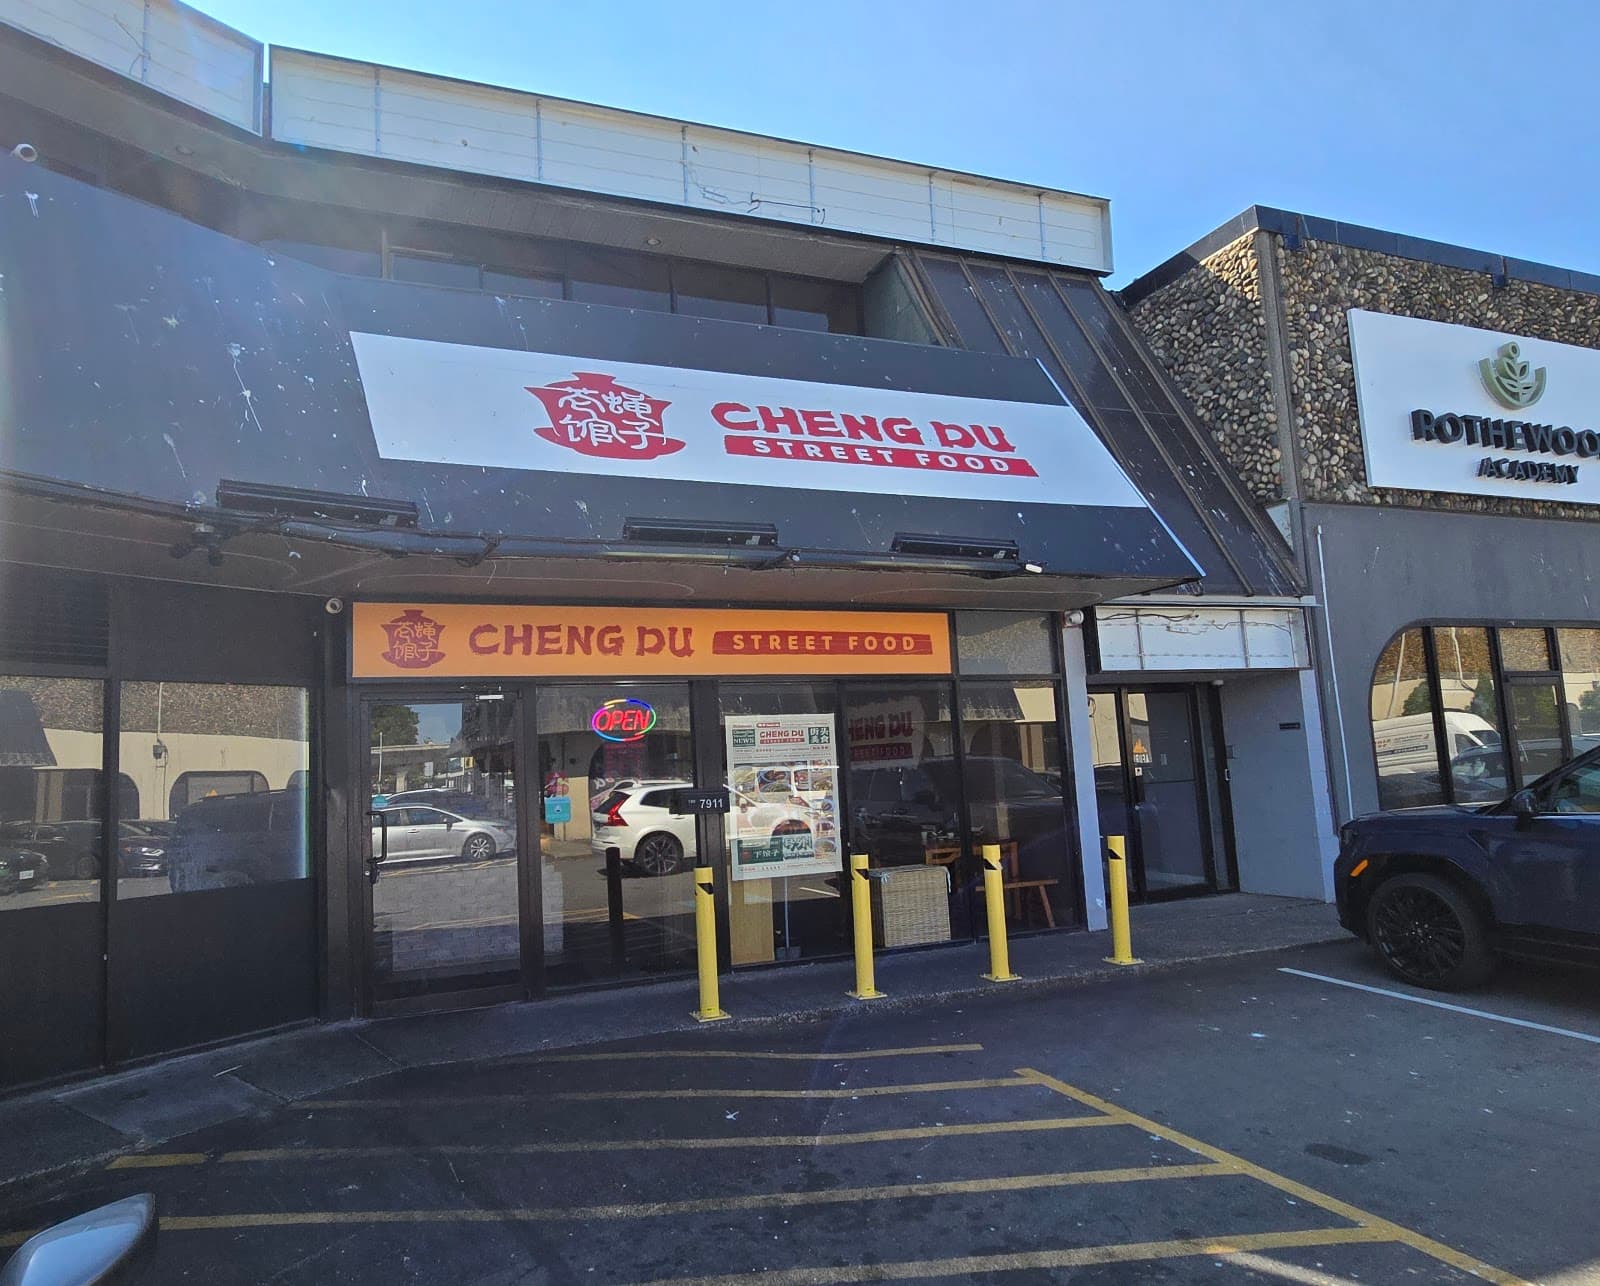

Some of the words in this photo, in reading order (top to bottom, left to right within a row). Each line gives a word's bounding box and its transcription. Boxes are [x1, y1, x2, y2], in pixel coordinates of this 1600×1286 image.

[710, 402, 925, 445] CHENG
[929, 421, 1016, 453] DU
[1410, 408, 1600, 460] ROTHEWOO
[752, 439, 894, 464] STREET
[915, 453, 1009, 473] FOOD
[1477, 457, 1579, 485] ACADEMY
[468, 623, 625, 656] CHENG
[635, 626, 695, 658] DU
[732, 633, 833, 651] STREET
[848, 635, 916, 652] FOOD
[595, 709, 651, 731] OPEN
[759, 729, 789, 738] CHENG
[791, 729, 804, 737] DU
[733, 737, 754, 745] NEWS
[699, 798, 723, 809] 7911
